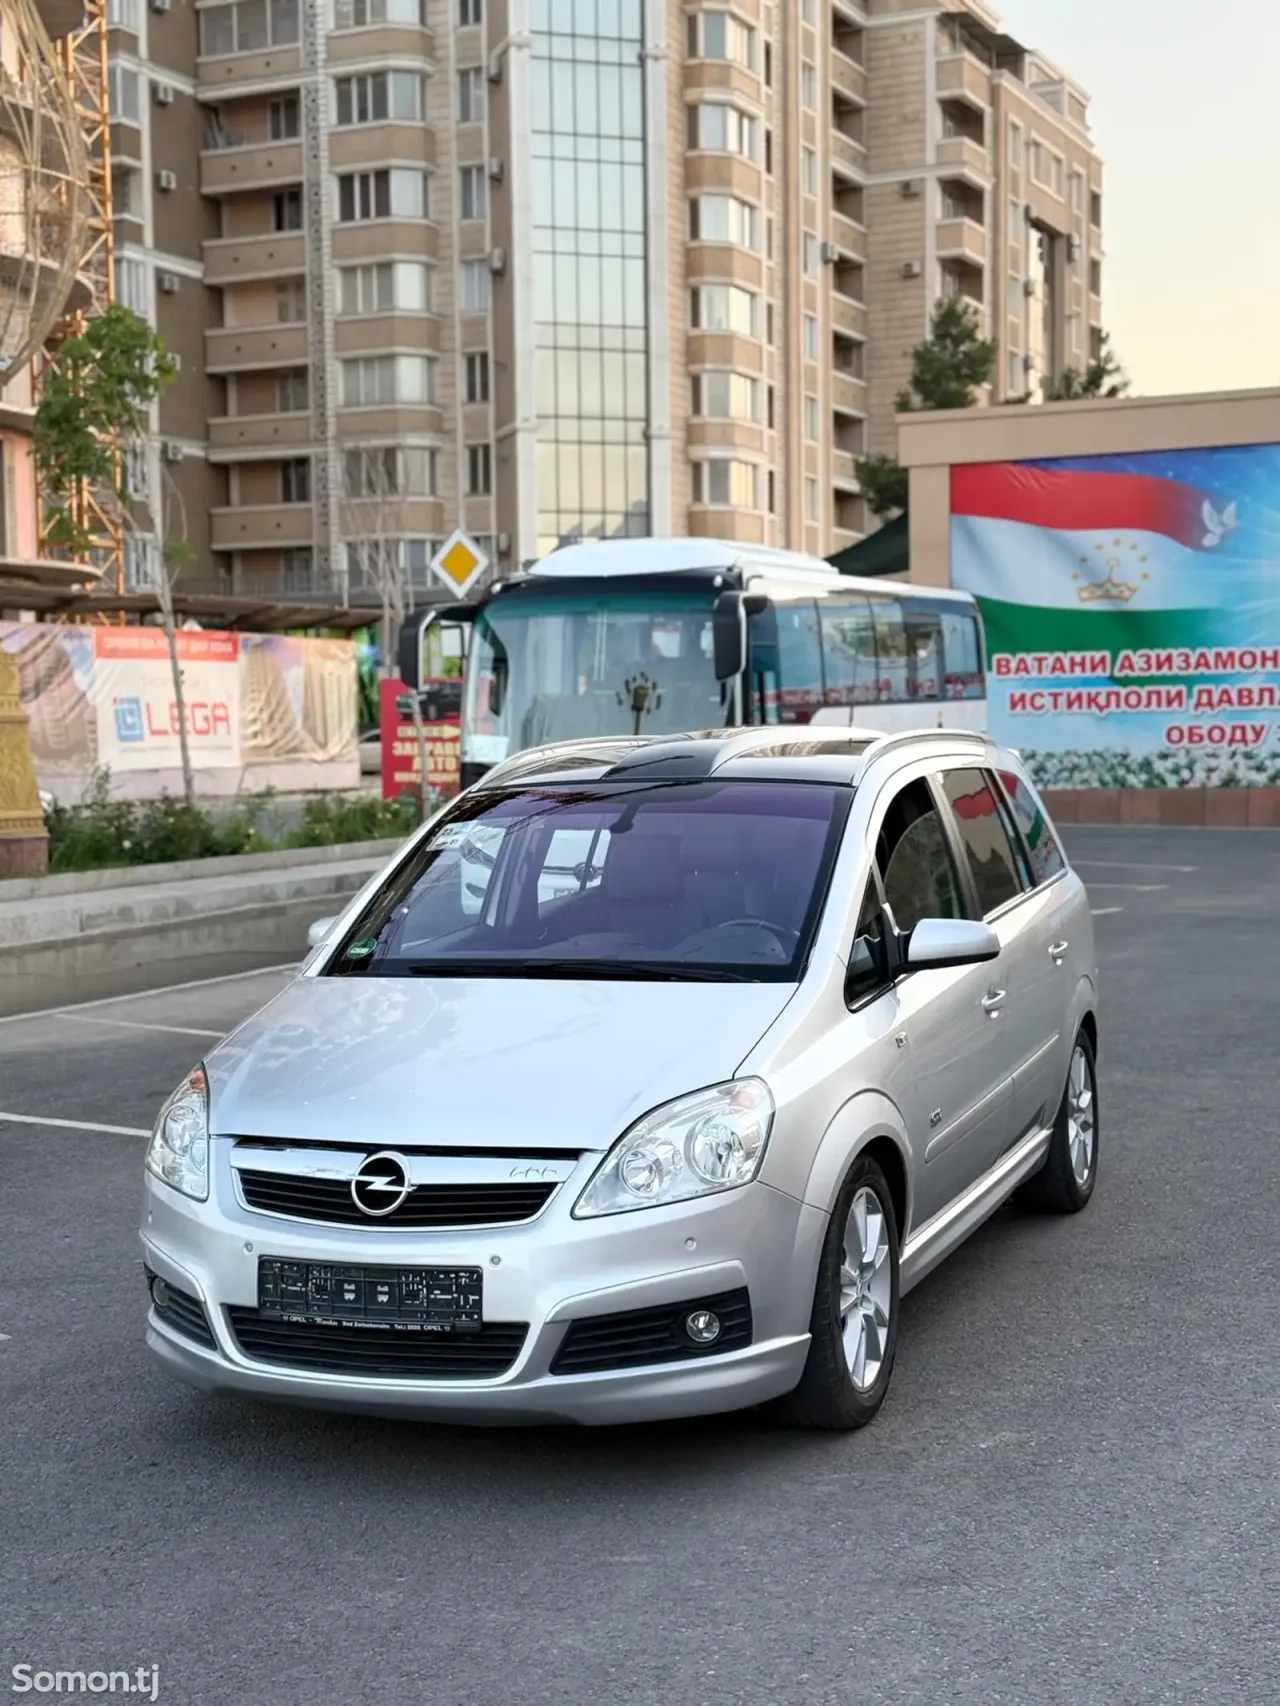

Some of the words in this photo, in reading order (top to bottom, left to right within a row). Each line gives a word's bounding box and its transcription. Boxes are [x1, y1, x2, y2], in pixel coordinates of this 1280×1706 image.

[994, 654, 1108, 676] ВАТАНИ
[1117, 649, 1279, 674] АЗИЗАМОН
[1009, 689, 1184, 713] ИСТИҚЛОЛИ
[1194, 686, 1280, 711] ДАВЛ
[145, 701, 231, 736] LEGA
[1165, 723, 1265, 747] ОБОДУ
[423, 1324, 442, 1332] OPEL
